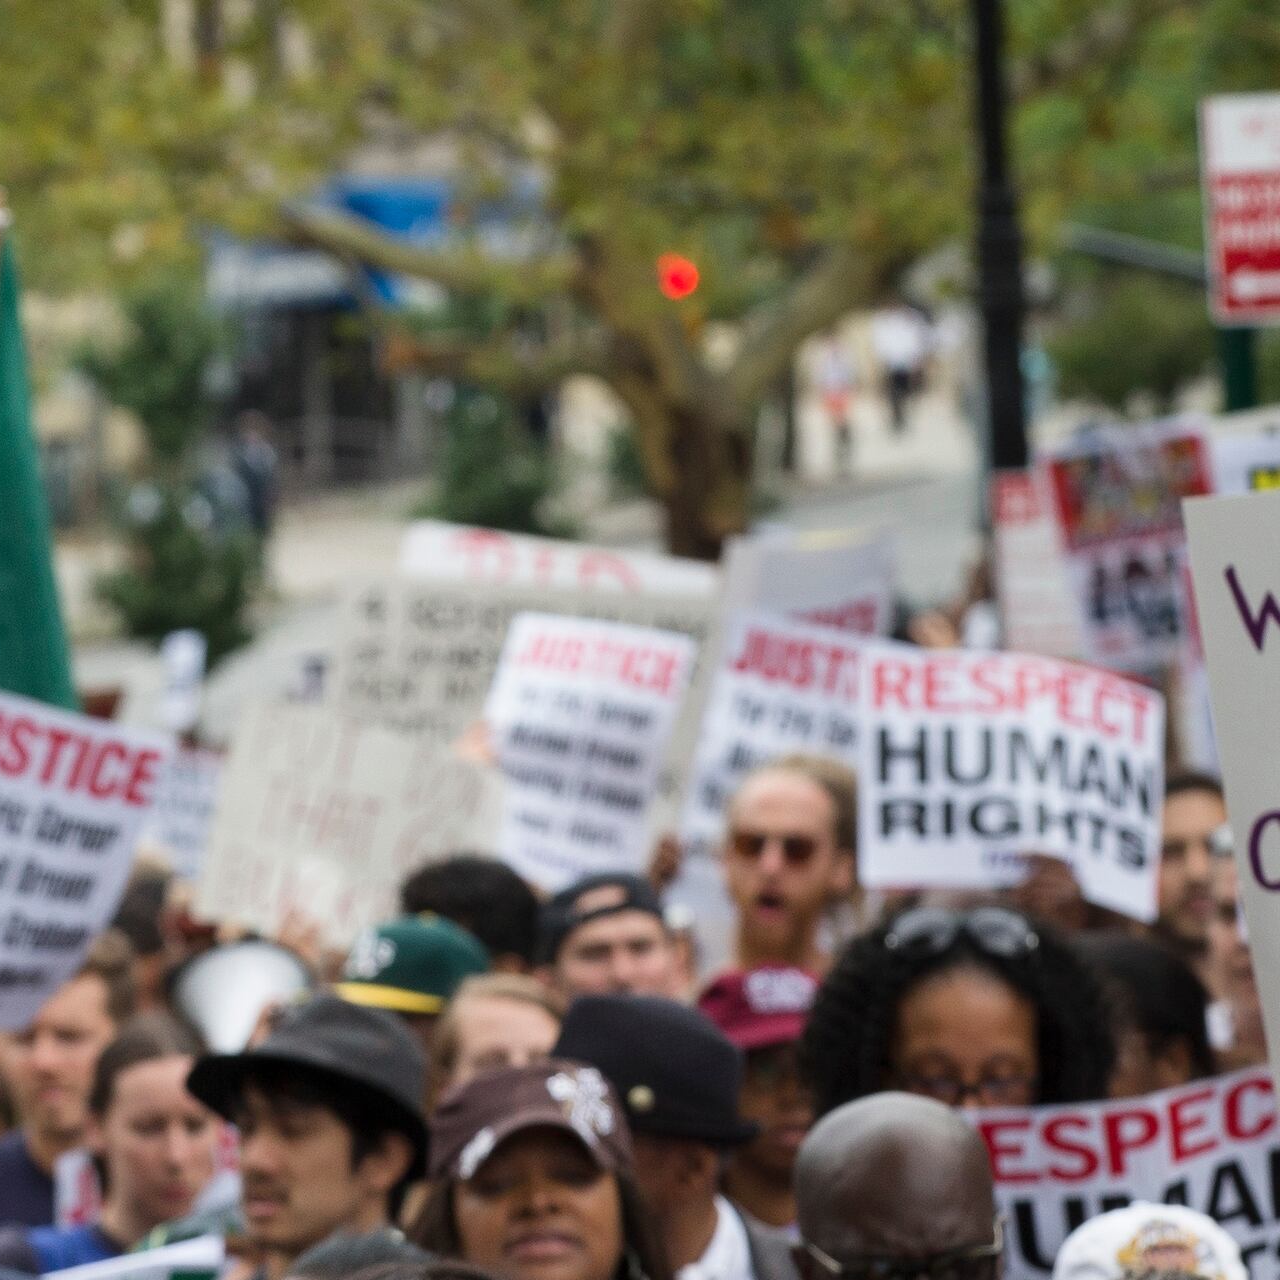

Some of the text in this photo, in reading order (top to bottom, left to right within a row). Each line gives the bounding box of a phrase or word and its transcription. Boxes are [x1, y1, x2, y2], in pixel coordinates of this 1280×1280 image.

[871, 655, 1150, 745] RESPECT
[876, 724, 1153, 813] HUMAN
[879, 798, 1148, 873] RIGHTS
[979, 1078, 1276, 1184] ESPEC
